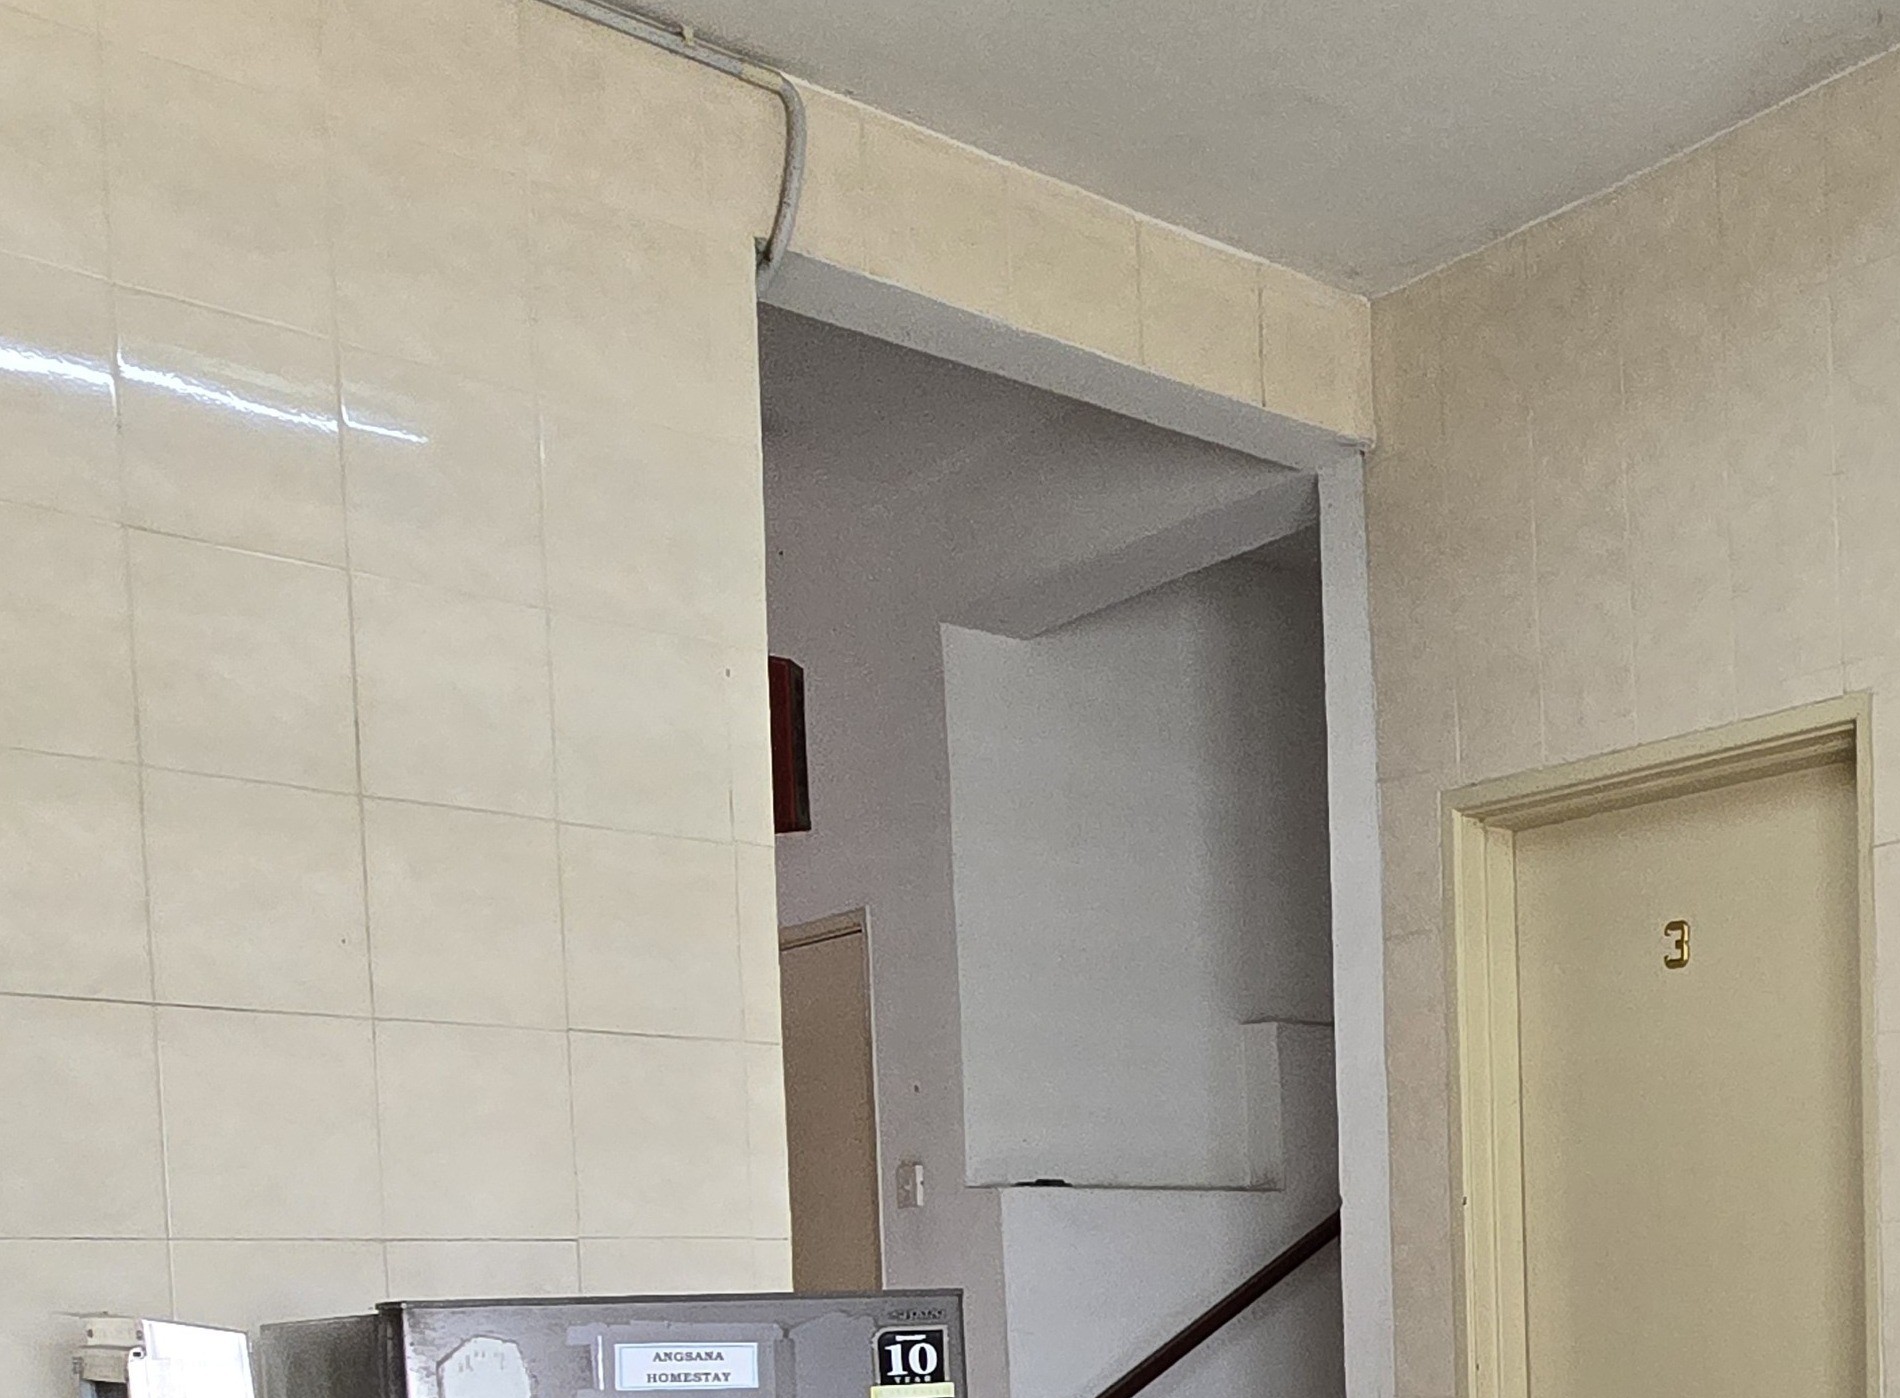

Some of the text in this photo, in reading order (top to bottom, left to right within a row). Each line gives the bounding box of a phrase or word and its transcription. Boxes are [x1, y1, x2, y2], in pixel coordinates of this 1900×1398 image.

[1664, 920, 1690, 969] 3
[652, 1351, 725, 1362] ANGSANA
[885, 1343, 938, 1376] 10
[646, 1372, 731, 1383] HOMESTAY
